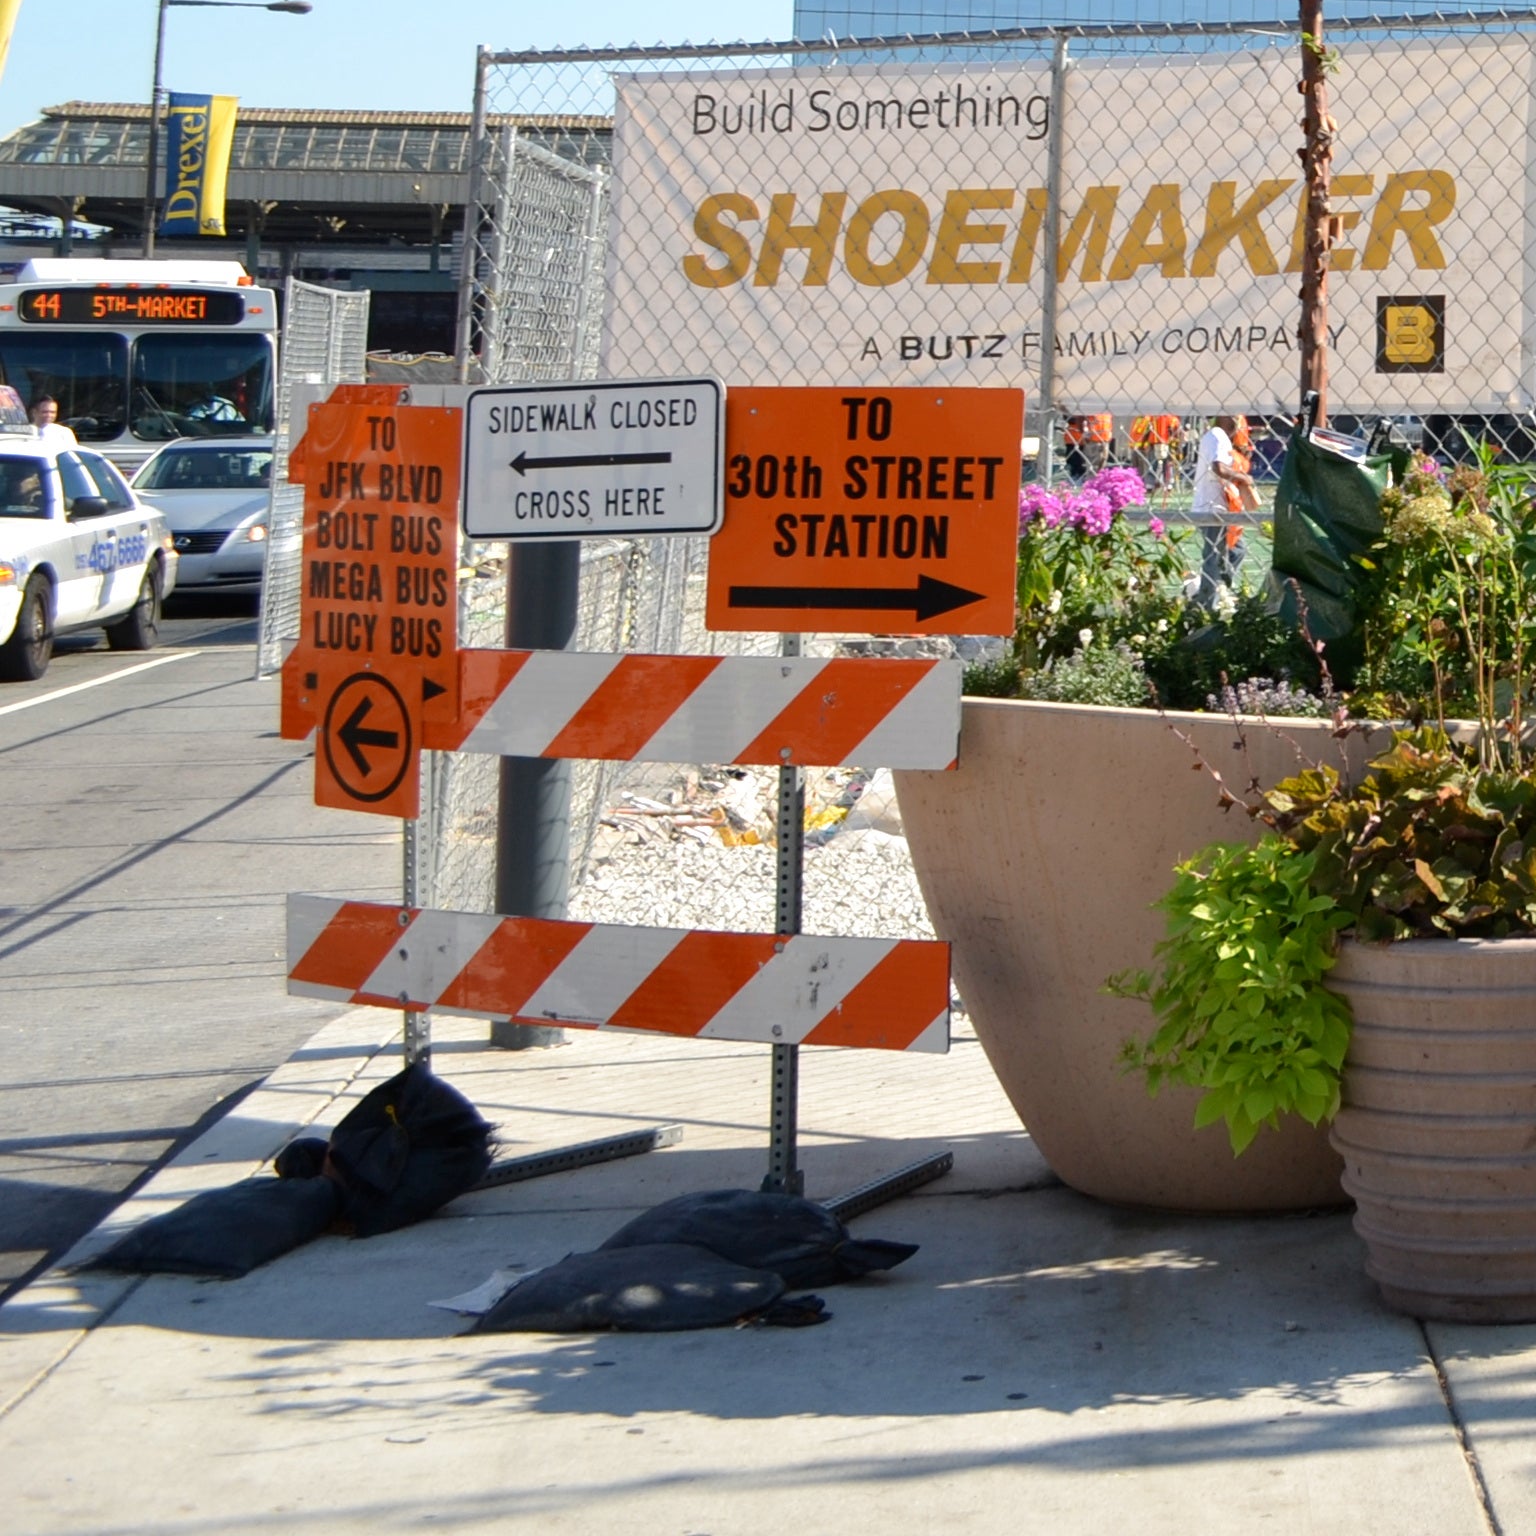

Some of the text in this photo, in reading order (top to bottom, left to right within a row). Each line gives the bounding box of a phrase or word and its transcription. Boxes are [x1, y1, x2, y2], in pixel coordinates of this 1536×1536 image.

[692, 83, 1051, 141] Build Something
[165, 105, 208, 222] Drexel
[682, 168, 1457, 291] SHOEMAKER
[32, 293, 61, 319] 44
[860, 336, 883, 362] A
[899, 334, 1006, 361] BUTZ
[1161, 322, 1348, 354] COMPAY
[367, 415, 397, 452] TO
[488, 398, 698, 434] SIDEWALK CLOSED
[842, 396, 892, 442] TO
[319, 461, 443, 504] JFK BLVD
[727, 454, 1004, 500] 30th STREET
[514, 486, 666, 520] CROSS HERE
[316, 510, 442, 556] BOLT BUS
[772, 513, 949, 559] STATION
[309, 560, 448, 608] MEGA BUS
[313, 610, 442, 659] LUCY BUS
